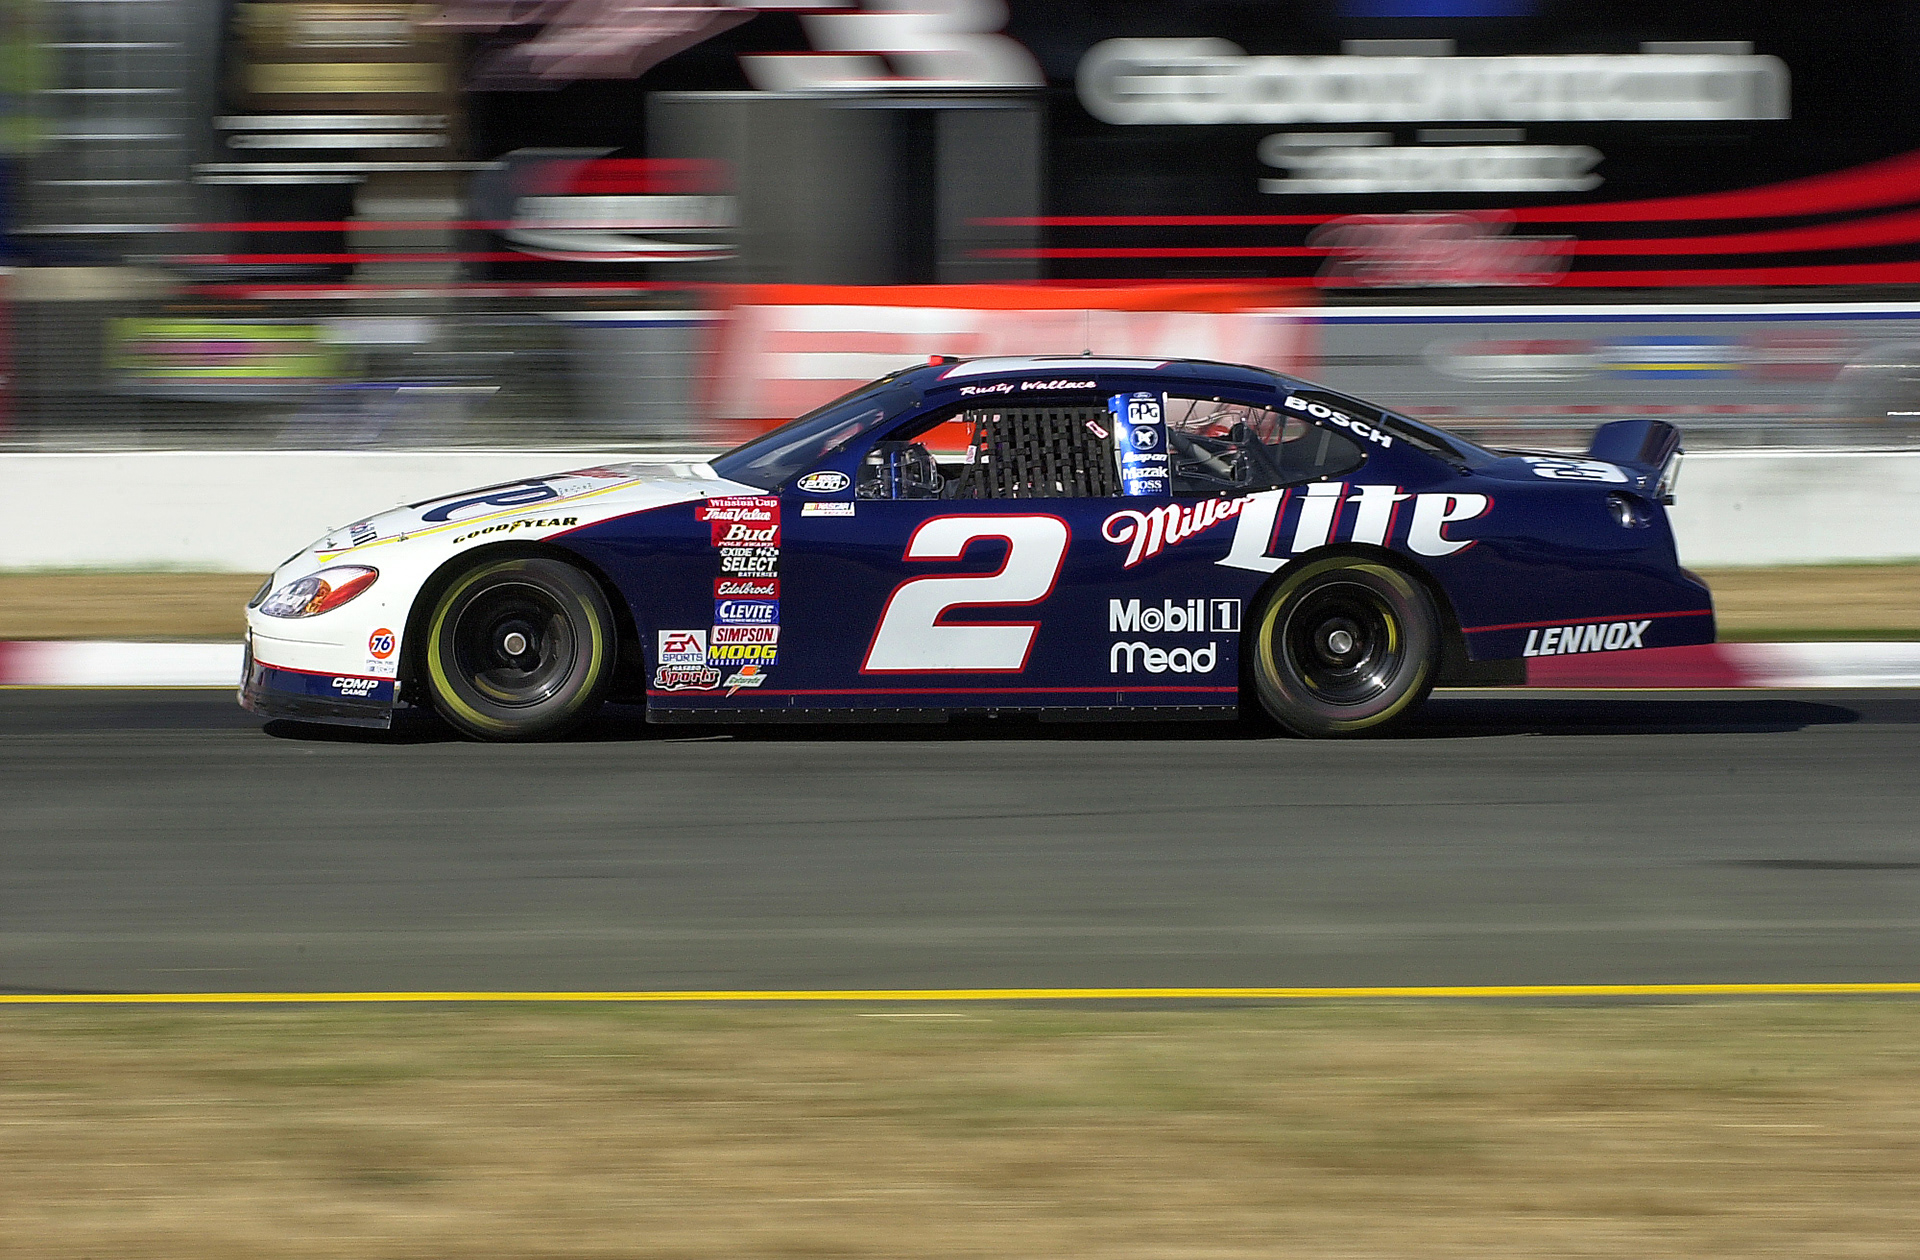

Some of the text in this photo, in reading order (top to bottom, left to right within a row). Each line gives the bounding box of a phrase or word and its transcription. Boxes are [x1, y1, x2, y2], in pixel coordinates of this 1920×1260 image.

[960, 380, 1097, 396] Rusty Wallace
[1130, 403, 1158, 420] PPG
[1284, 396, 1392, 448] BOSCH
[1123, 466, 1168, 479] Mazak
[710, 499, 778, 508] Winston Cup
[453, 517, 578, 544] GOODYEAR
[723, 524, 779, 541] Bud
[1102, 481, 1494, 574] Miller Lite
[720, 547, 754, 557] EXIDE
[721, 557, 777, 571] SELECT
[718, 582, 775, 595] Edelbrock
[859, 513, 1072, 673] 2
[720, 600, 774, 618] CLEVITE
[1109, 598, 1236, 632] Mobil 1
[372, 634, 393, 653] 76
[663, 633, 702, 653] EA
[716, 628, 774, 642] SIMPSON
[1523, 620, 1652, 657] LENNOX
[663, 653, 703, 662] SPORTS
[707, 645, 778, 660] MOOG
[332, 677, 379, 689] COMP
